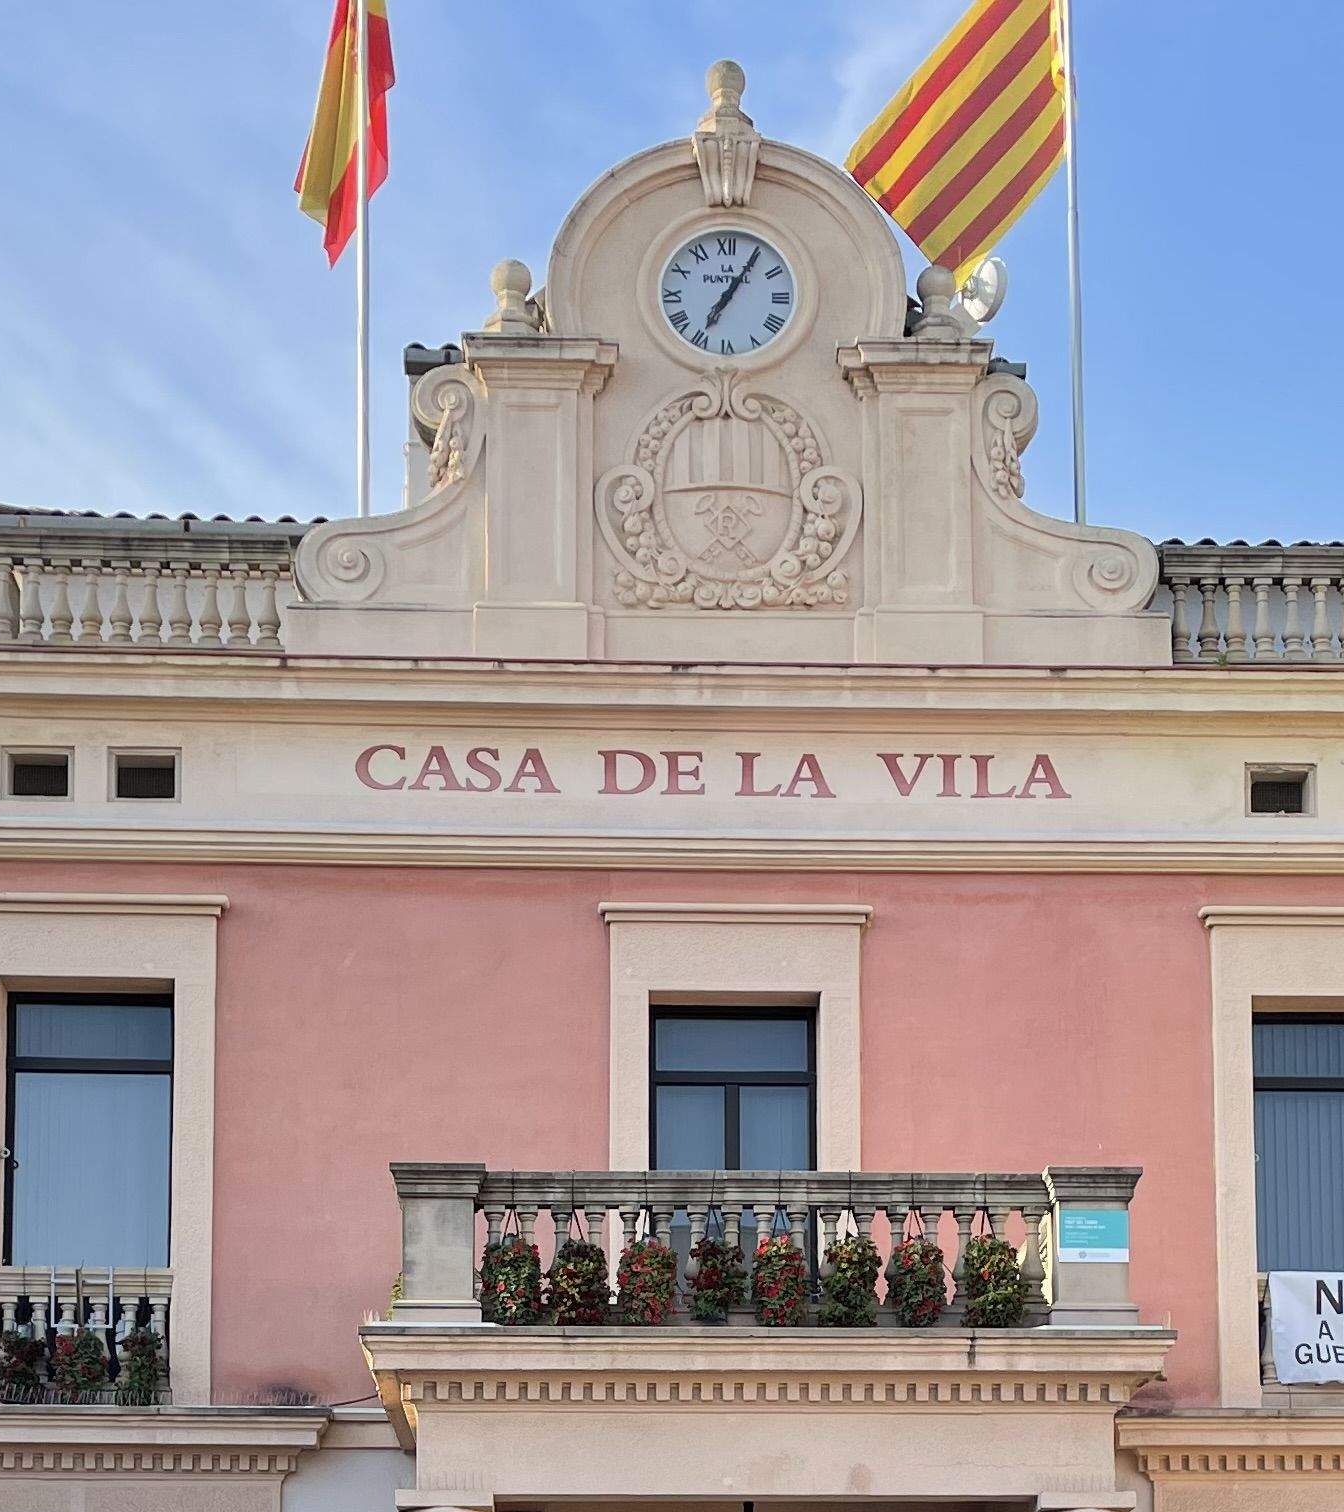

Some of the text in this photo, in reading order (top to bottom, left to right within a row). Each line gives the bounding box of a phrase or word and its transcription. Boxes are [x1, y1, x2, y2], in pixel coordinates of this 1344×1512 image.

[717, 237, 736, 256] XII
[671, 263, 691, 280] X
[720, 264, 734, 273] LA
[702, 274, 751, 284] PUNTL
[354, 743, 1072, 799] CASA DE LA VILA
[1318, 1319, 1335, 1342] A
